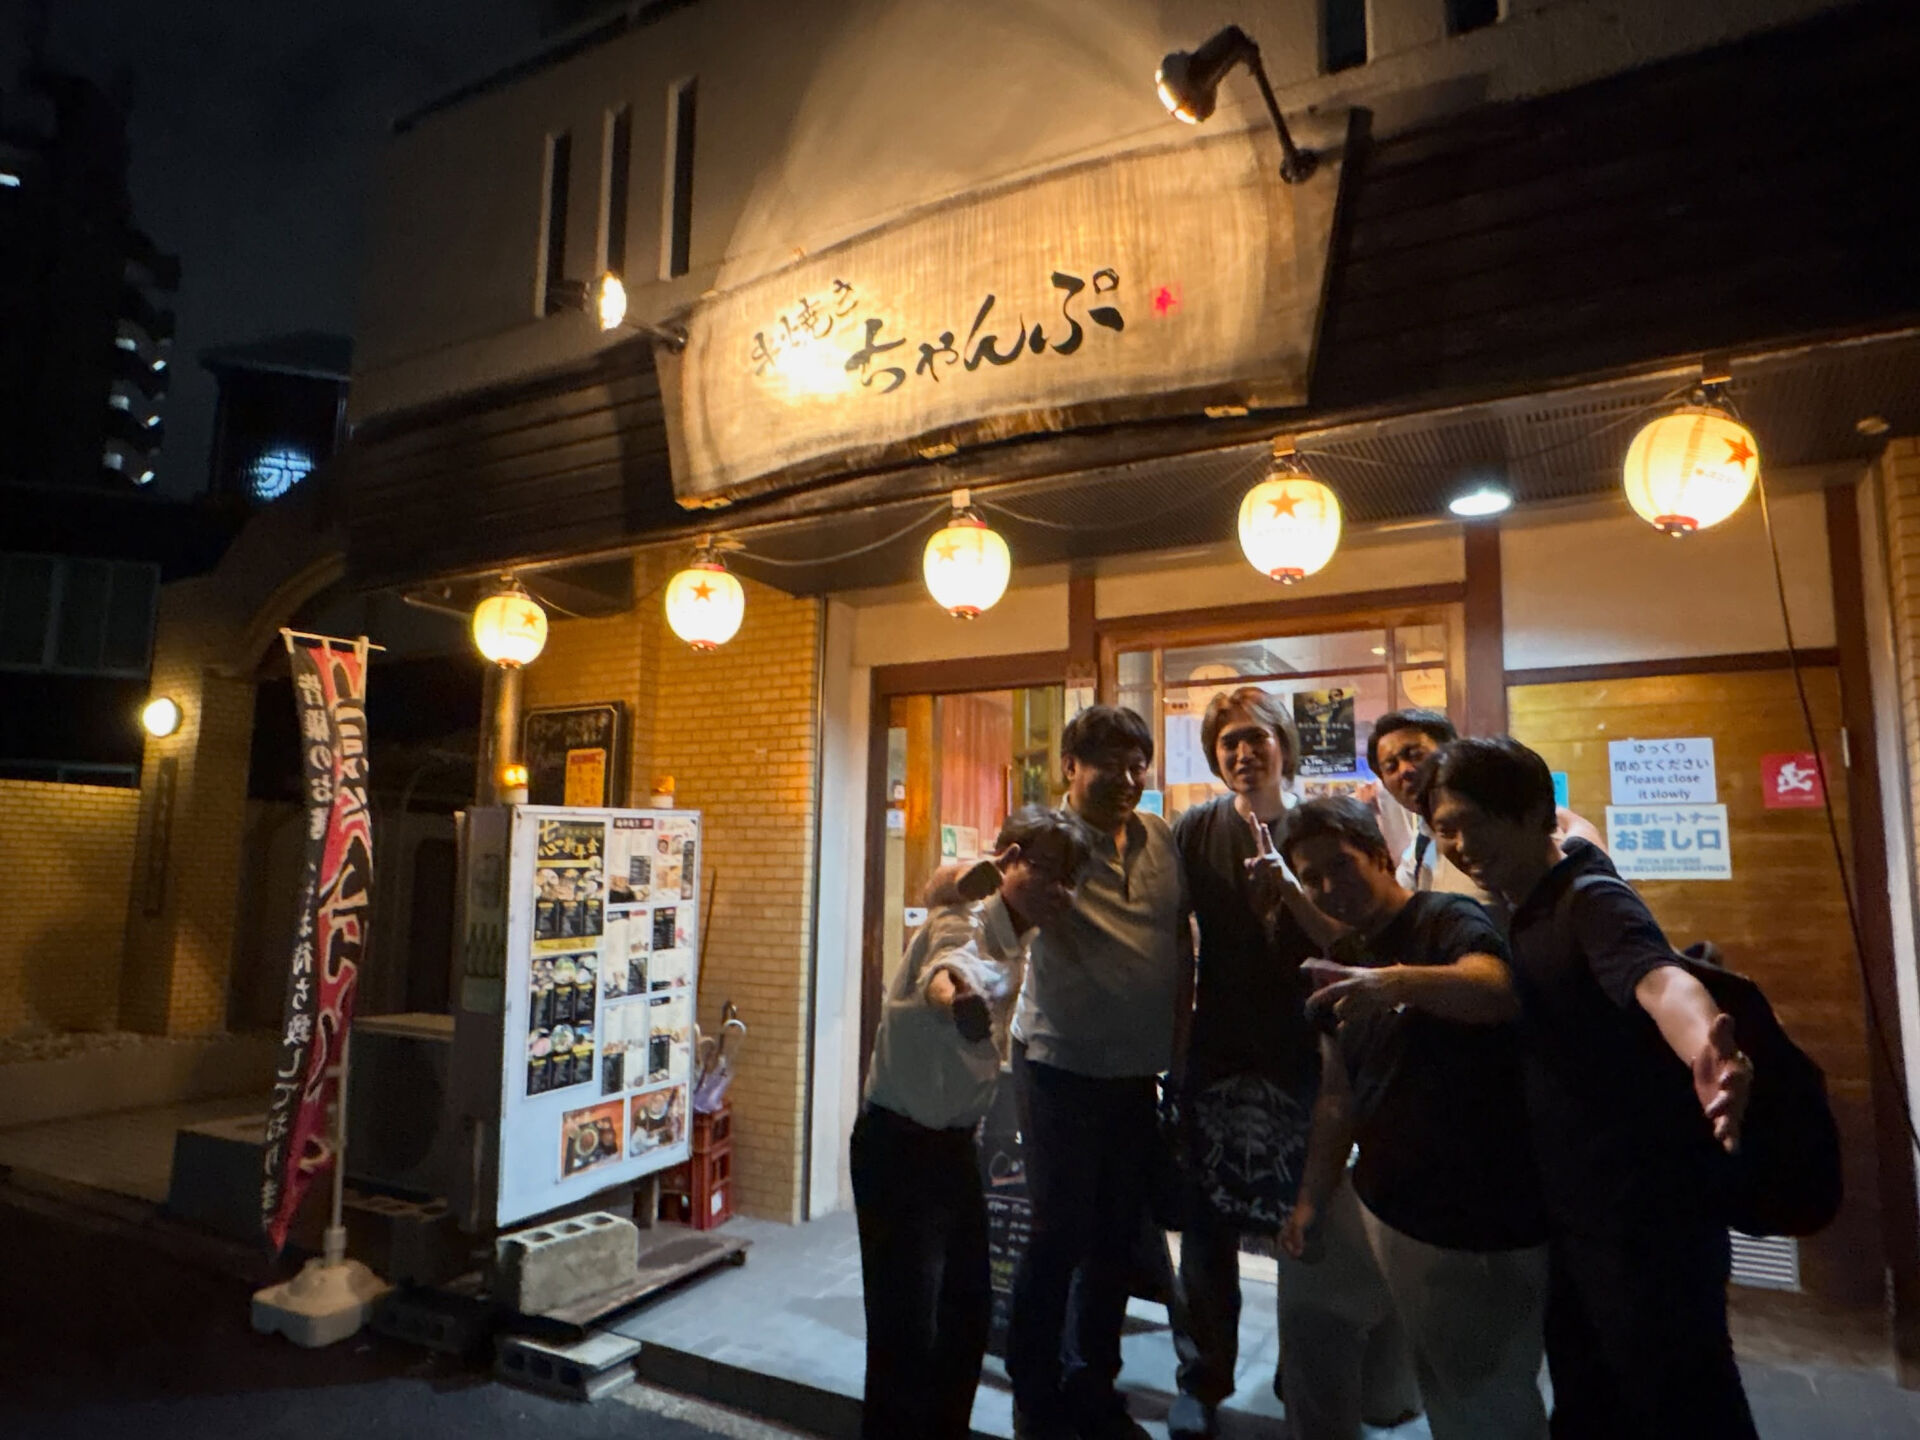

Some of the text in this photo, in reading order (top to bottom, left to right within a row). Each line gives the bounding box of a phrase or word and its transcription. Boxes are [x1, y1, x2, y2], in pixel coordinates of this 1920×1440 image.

[845, 268, 1124, 394] ちゃんぷ
[1634, 742, 1687, 755] ゆっくり
[1625, 773, 1701, 785] Please close
[1638, 788, 1691, 801] it slowly
[1615, 828, 1722, 852] お渡し口
